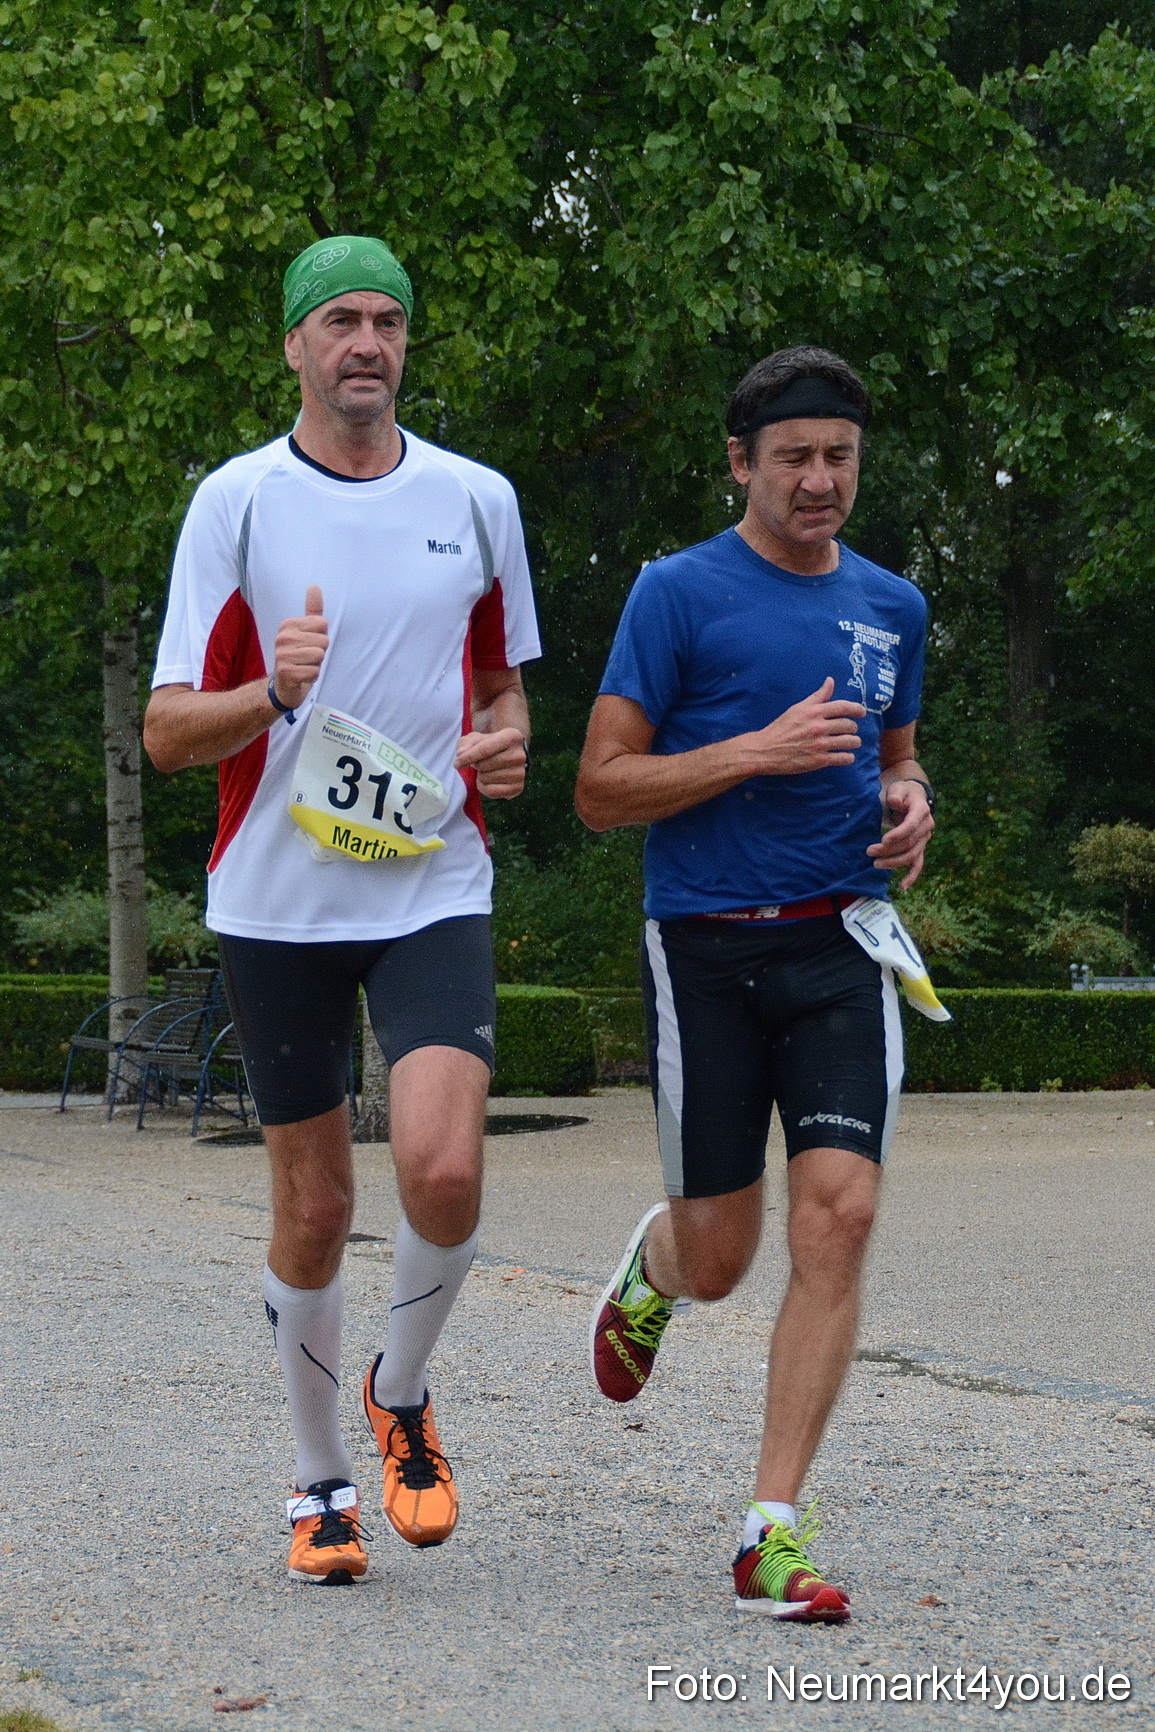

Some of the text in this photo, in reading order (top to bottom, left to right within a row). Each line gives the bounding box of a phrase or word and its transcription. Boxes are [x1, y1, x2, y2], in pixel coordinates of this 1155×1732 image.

[427, 539, 462, 555] Martin
[838, 620, 854, 631] 12.
[322, 725, 371, 750] NeuerMarkt
[296, 793, 303, 803] B
[605, 1329, 647, 1384] BROOKS
